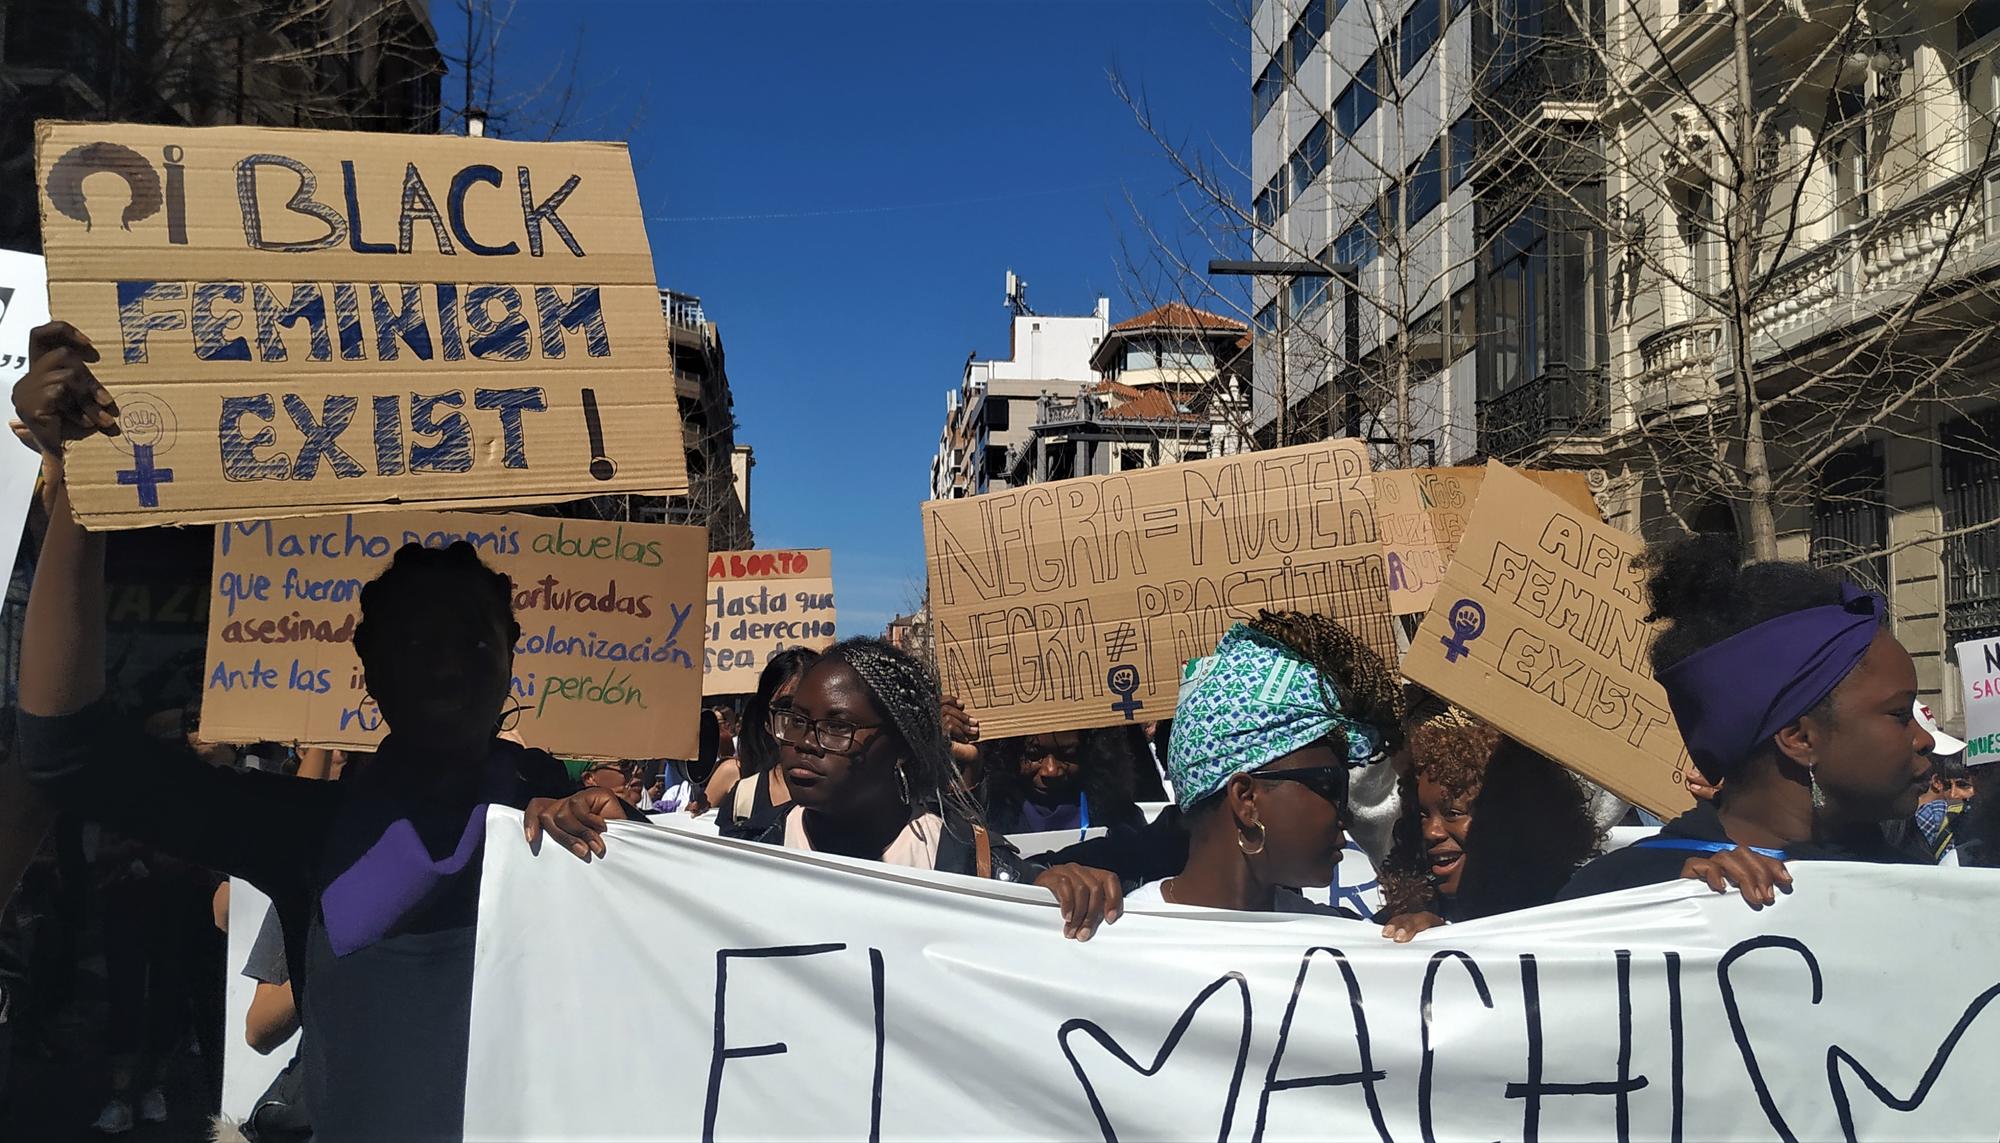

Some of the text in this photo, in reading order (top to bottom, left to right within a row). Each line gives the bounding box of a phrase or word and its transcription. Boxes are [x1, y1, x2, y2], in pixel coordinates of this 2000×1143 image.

[234, 153, 585, 257] BLACK
[114, 281, 611, 365] FEMINISM
[222, 514, 391, 558] Marcho
[532, 523, 664, 567] abuelas
[708, 552, 808, 578] ABORTO
[932, 476, 1147, 605] NEGRA
[1181, 448, 1377, 567] MUJER
[1537, 512, 1653, 606] AFR
[219, 571, 271, 617] que
[221, 610, 356, 644] asesinad
[209, 659, 279, 691] Ante
[288, 659, 331, 694] las
[536, 667, 648, 720] perdón
[940, 598, 1104, 709] NEGRA
[1497, 628, 1671, 749] EXIST
